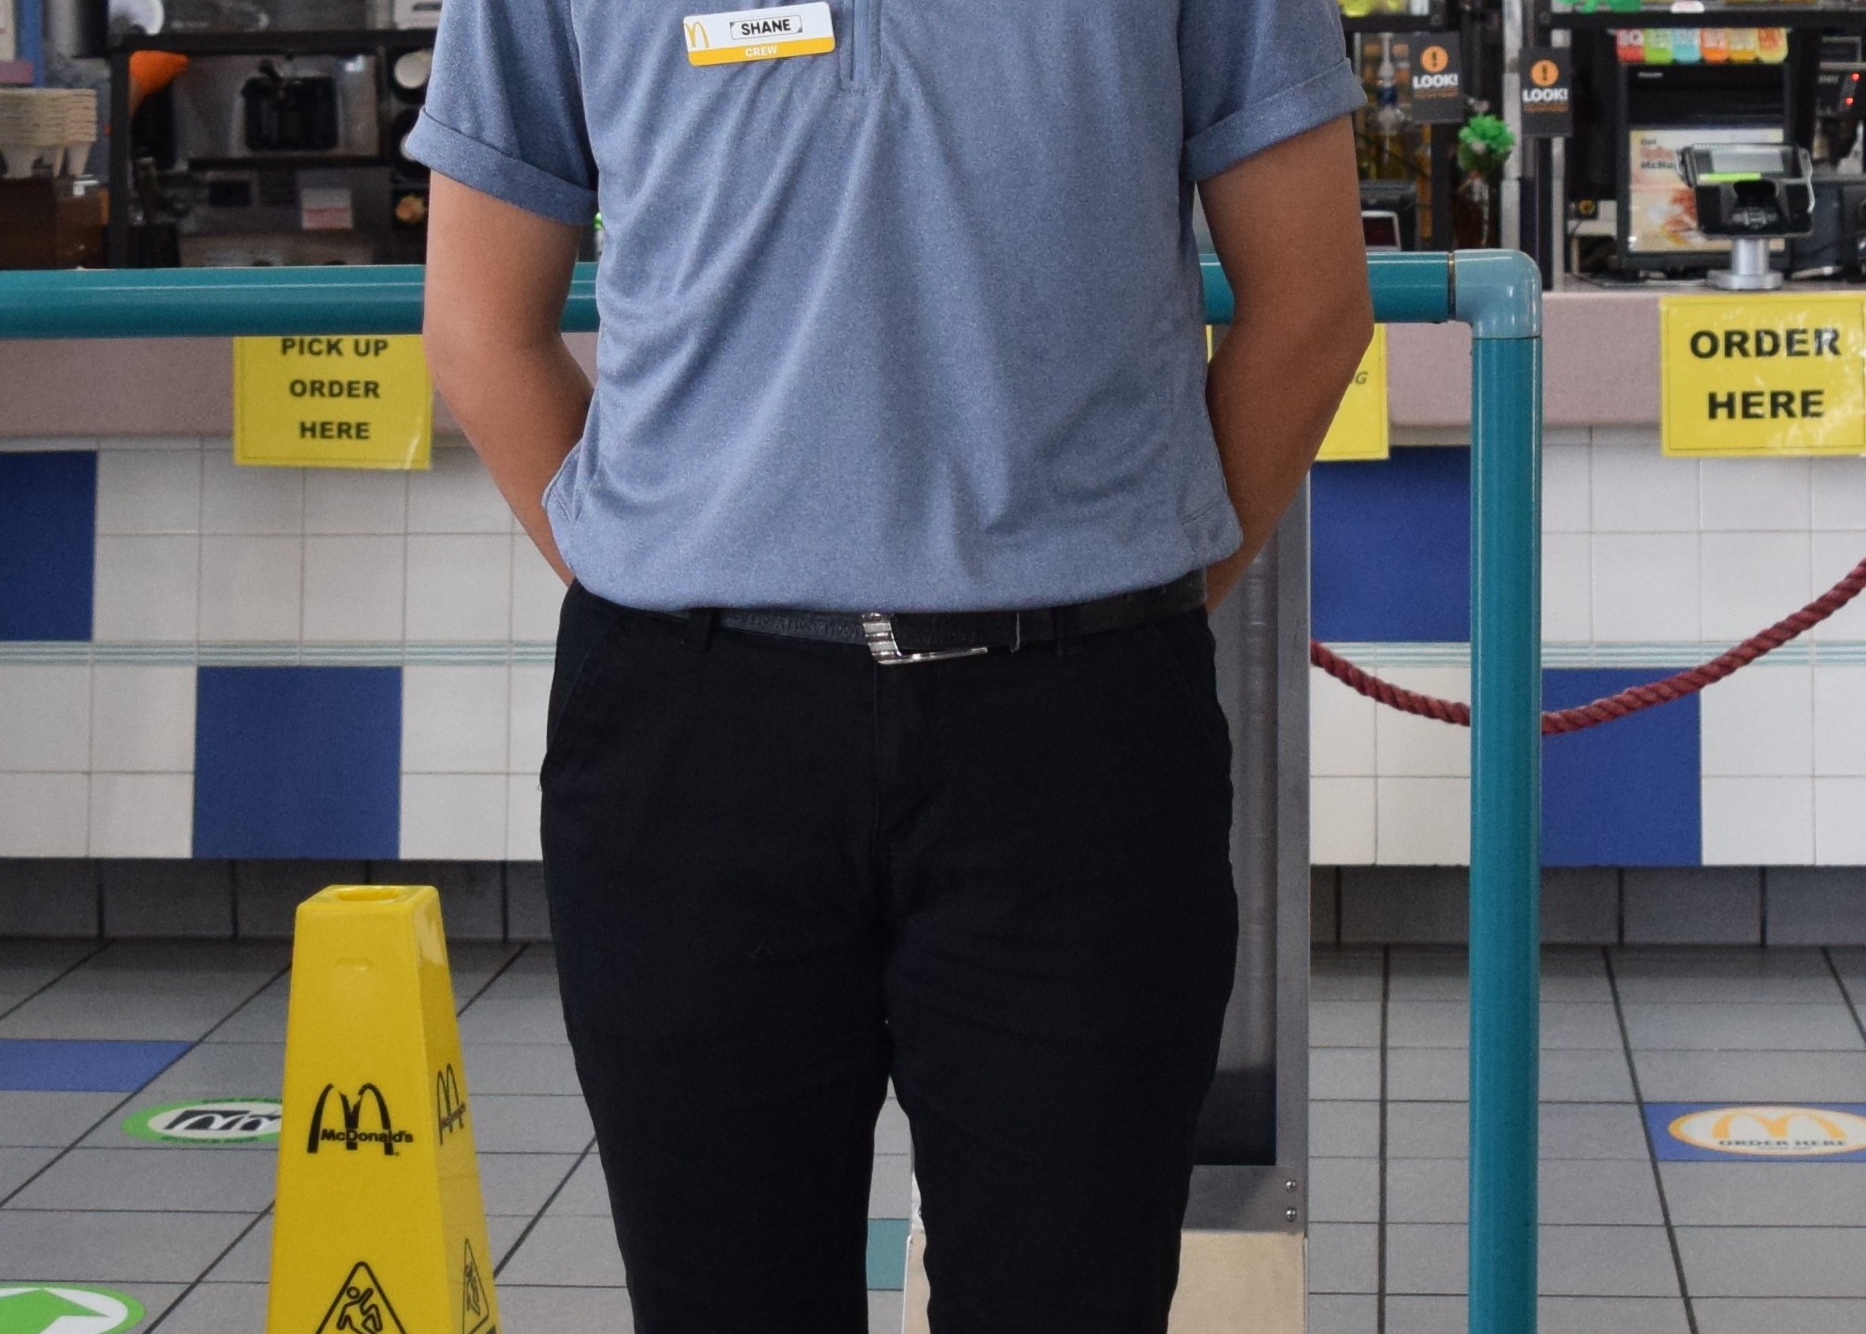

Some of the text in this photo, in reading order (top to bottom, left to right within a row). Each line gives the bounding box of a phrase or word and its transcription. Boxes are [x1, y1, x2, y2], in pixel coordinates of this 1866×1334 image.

[741, 18, 791, 36] SHANE
[745, 45, 778, 58] CREW
[1412, 73, 1459, 89] LOOK!
[1522, 88, 1569, 103] LOOK!
[281, 337, 389, 357] PICK UP
[1690, 328, 1842, 359] ORDER
[289, 378, 381, 399] ORDER
[1708, 389, 1824, 420] HERE
[299, 421, 371, 440] HERE
[321, 1128, 413, 1144] McDonald's
[1718, 1139, 1846, 1147] ORDER HERE
